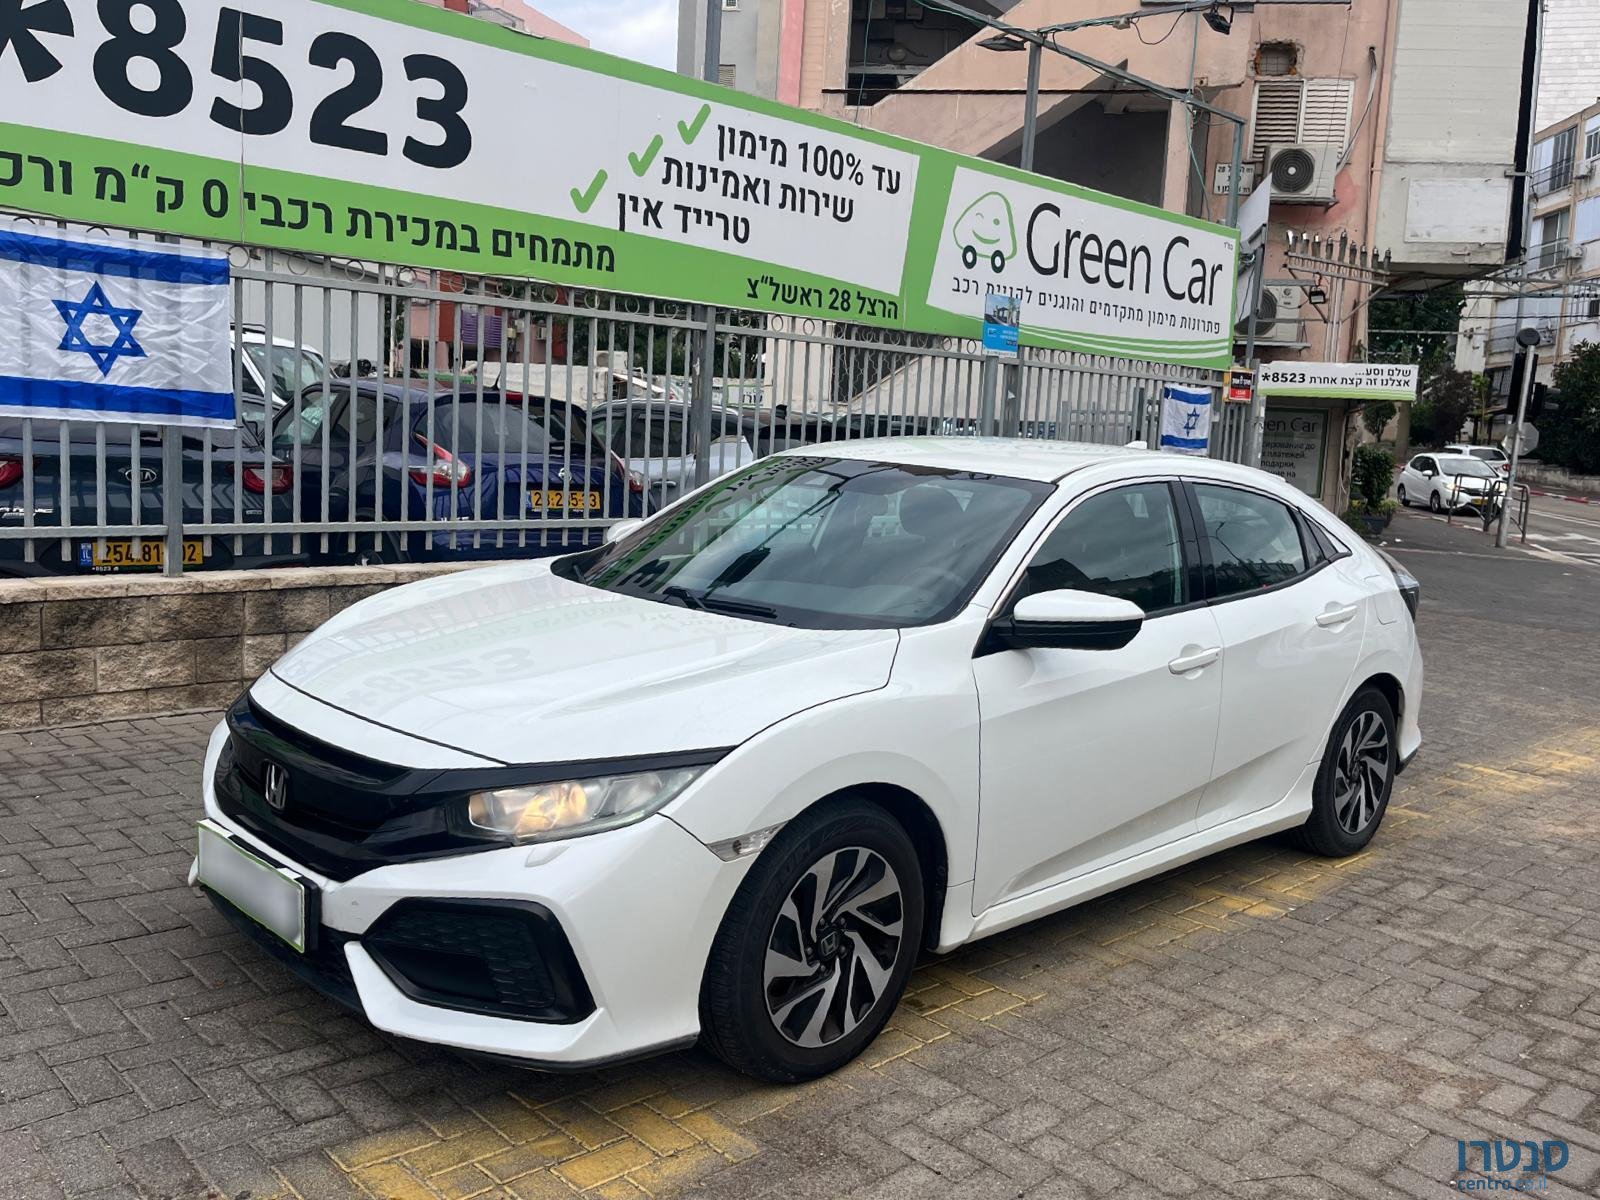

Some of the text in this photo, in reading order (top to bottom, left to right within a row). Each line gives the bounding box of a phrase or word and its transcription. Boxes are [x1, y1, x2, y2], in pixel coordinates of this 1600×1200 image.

[717, 124, 901, 195] עד 100% מימון
[662, 157, 854, 223] שירות ואמינות
[243, 191, 333, 234] רכבי
[617, 193, 750, 244] טרייד אין
[346, 207, 480, 254] במכירת
[491, 228, 615, 273] מתמחים
[1026, 202, 1223, 306] Green Car
[952, 277, 979, 296] רכב
[828, 288, 851, 312] 28
[856, 291, 899, 320] הרצל
[1039, 291, 1084, 312] והוגנים
[1090, 300, 1143, 322] מתקדמים
[1148, 309, 1176, 328] מימון
[1181, 317, 1221, 335] פתרונות
[1309, 376, 1410, 388] אצלנו זה קצת אחרת
[1388, 368, 1411, 377] שלם
